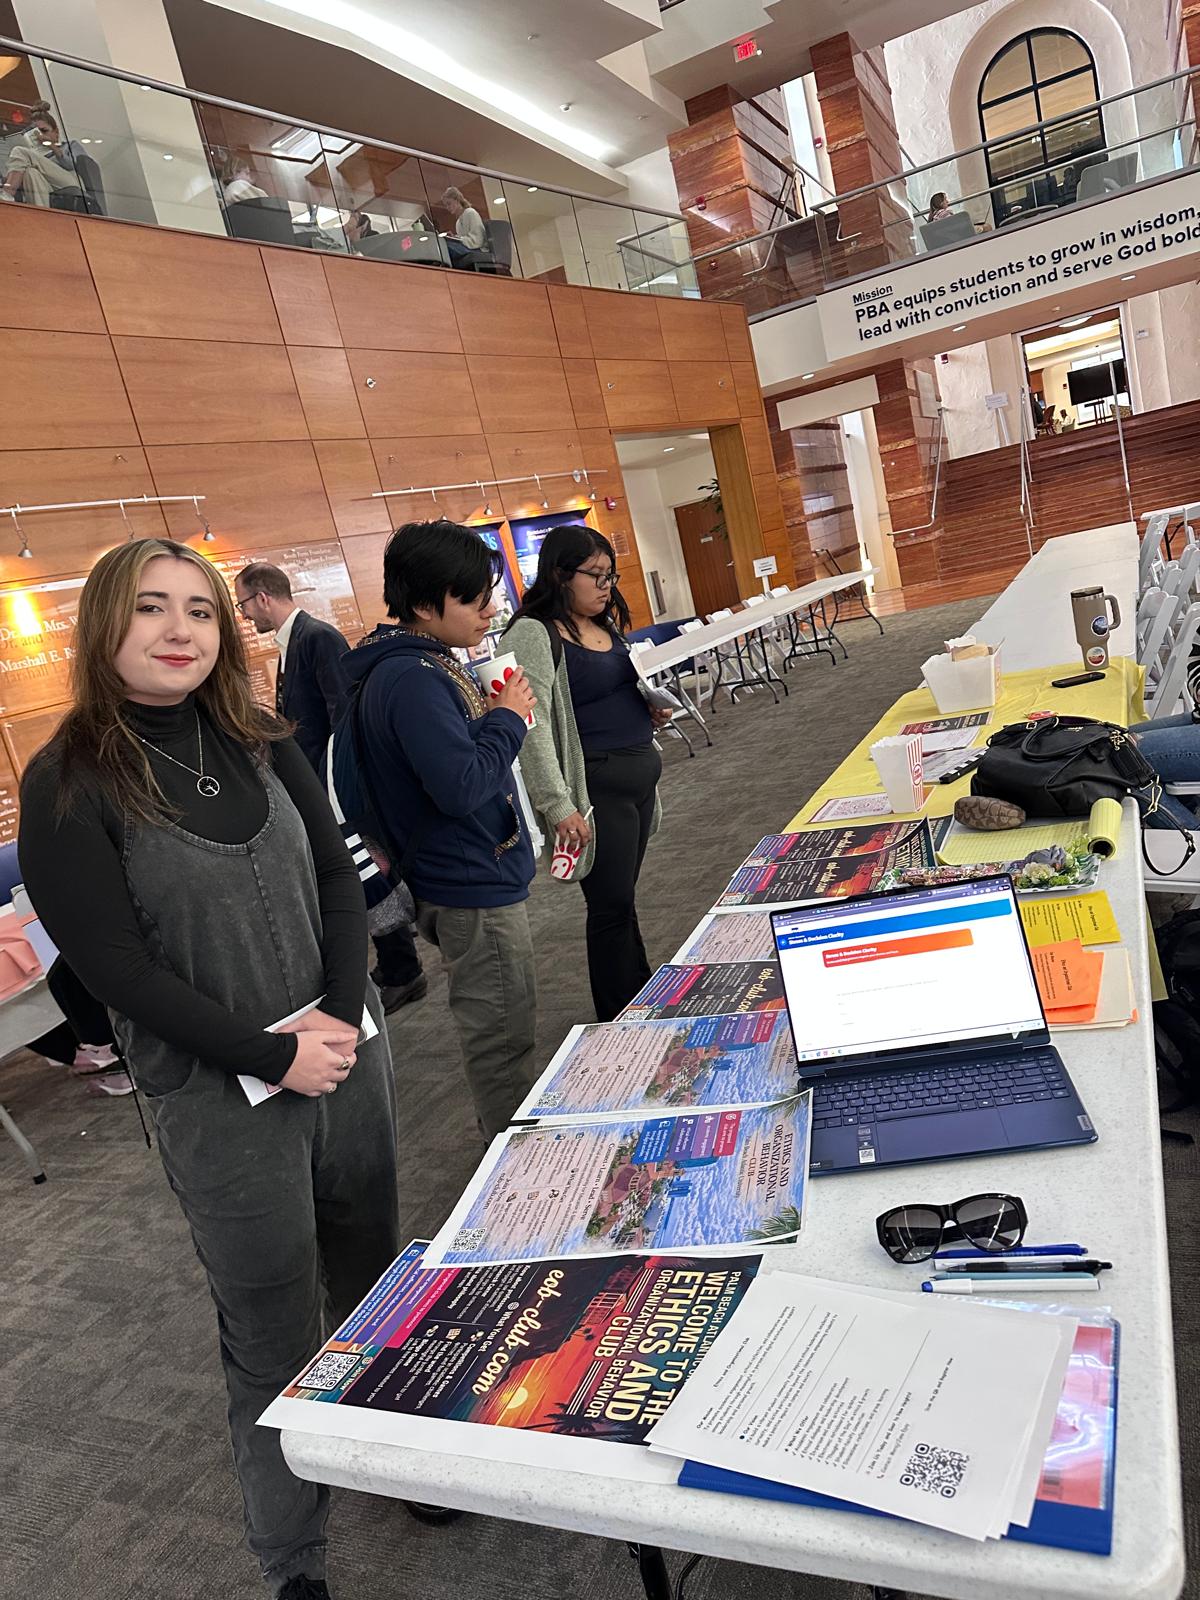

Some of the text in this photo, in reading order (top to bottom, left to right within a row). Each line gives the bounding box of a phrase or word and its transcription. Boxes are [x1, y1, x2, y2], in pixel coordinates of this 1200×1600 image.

[852, 284, 893, 304] Mission
[855, 304, 890, 323] PBA
[893, 285, 946, 312] equips
[950, 259, 1025, 294] students
[1028, 252, 1047, 269] to
[1051, 238, 1096, 265] grow
[1099, 230, 1117, 248] in
[859, 320, 892, 341] lead
[895, 308, 931, 331] with
[934, 281, 1022, 318] conviction
[1026, 269, 1059, 289] and
[1062, 253, 1113, 277] serve
[1117, 237, 1157, 261] God
[0, 650, 64, 673] Marshall E.
[747, 1157, 757, 1176] CLUB
[755, 1142, 771, 1185] BEHAVIOR
[764, 1124, 784, 1202] ORGANIZATIONAL
[778, 1132, 793, 1186] ETHICS AND
[579, 1143, 615, 1220] Connect Learn Lead Serve
[493, 1289, 514, 1311] professors
[722, 1271, 742, 1294] PALM
[671, 1270, 728, 1353] WELCOME
[710, 1296, 731, 1322] BEACH
[471, 1269, 563, 1395] eob-club.com
[475, 1310, 513, 1352] What You Get
[582, 1269, 674, 1418] ORGANIZATIONAL BEHAVIOR
[592, 1315, 633, 1357] CLUB
[600, 1270, 705, 1422] ETHICS AND
[423, 1341, 452, 1372] Find the word
[448, 1343, 476, 1374] Competitions
[657, 1358, 689, 1381] TO
[338, 1365, 364, 1390] Join Now
[431, 1380, 450, 1397] Games
[636, 1387, 676, 1425] THE
